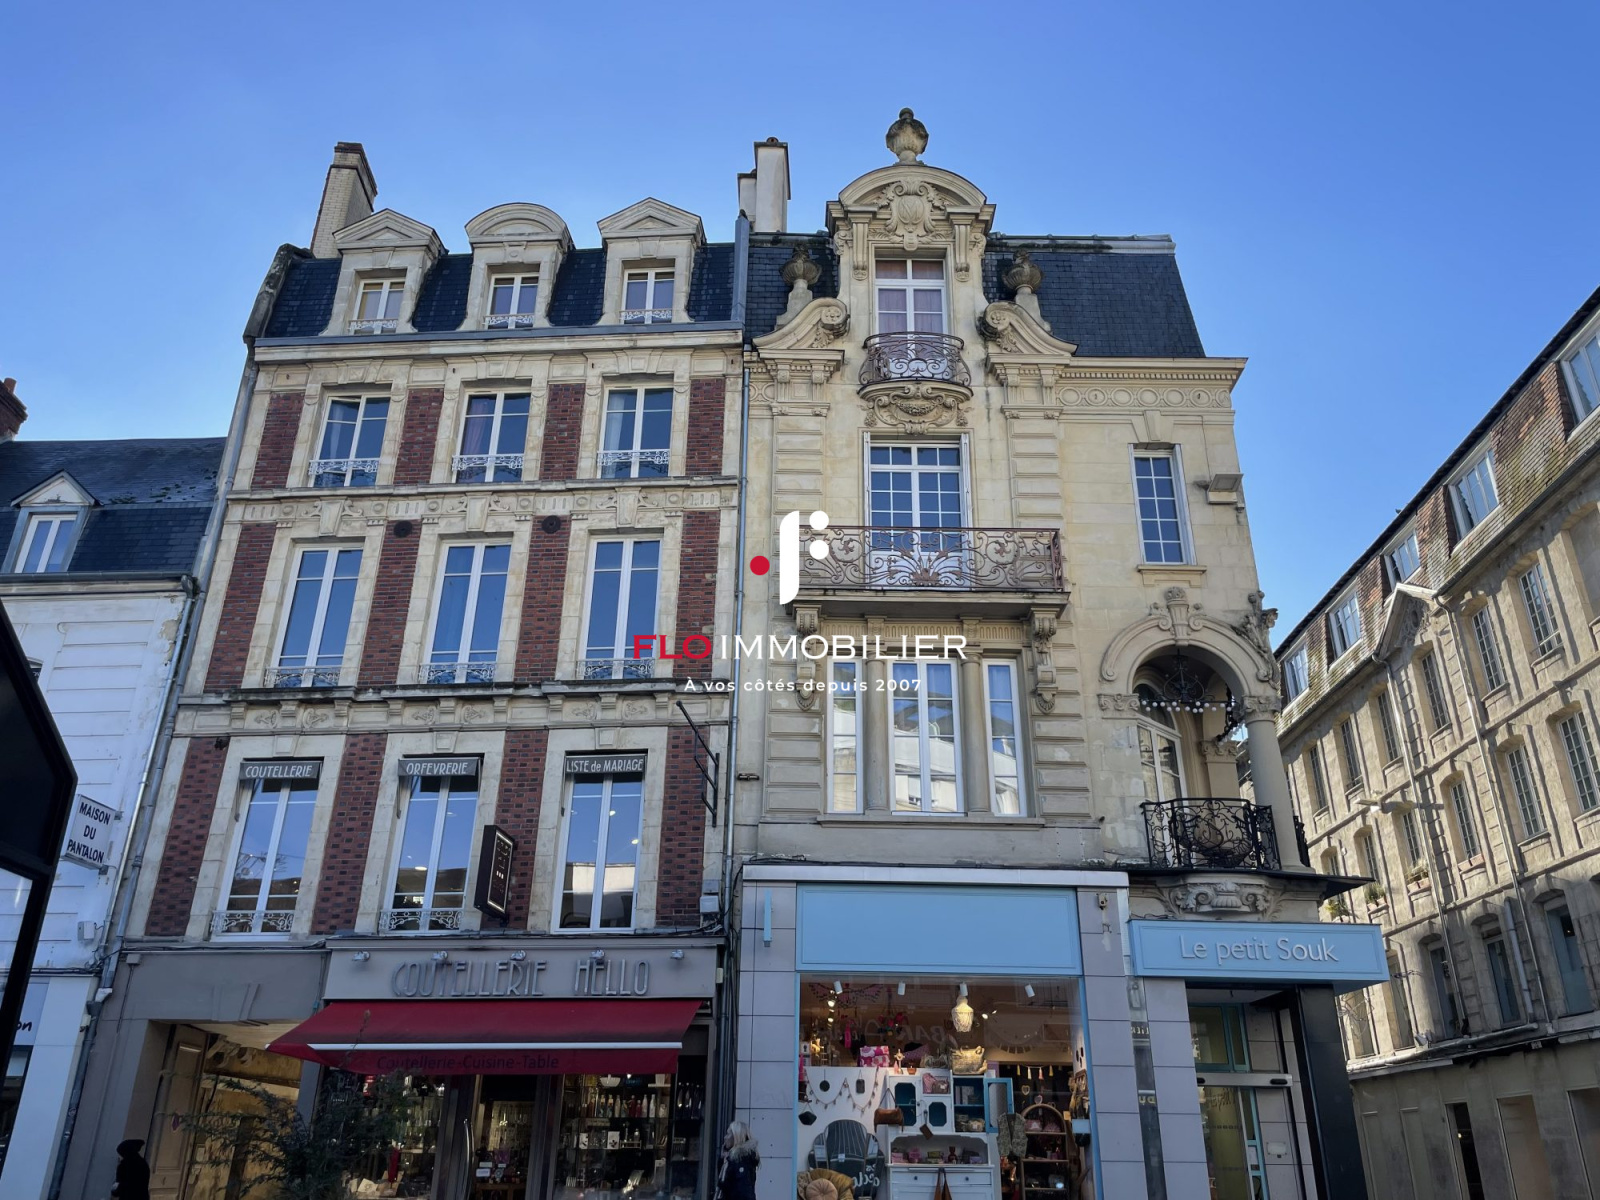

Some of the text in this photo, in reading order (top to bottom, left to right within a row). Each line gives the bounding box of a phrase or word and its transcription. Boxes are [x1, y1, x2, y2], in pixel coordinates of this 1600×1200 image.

[245, 765, 313, 778] COUTELLERIE
[406, 762, 469, 776] ORFEVRERIE
[566, 758, 644, 773] LISTE de MARIAGE
[79, 801, 111, 826] MAISON
[83, 825, 97, 840] DU
[66, 839, 105, 864] PANTALON
[1179, 935, 1339, 966] Le petit Souk
[391, 959, 650, 997] COUTELLERIE HELLO
